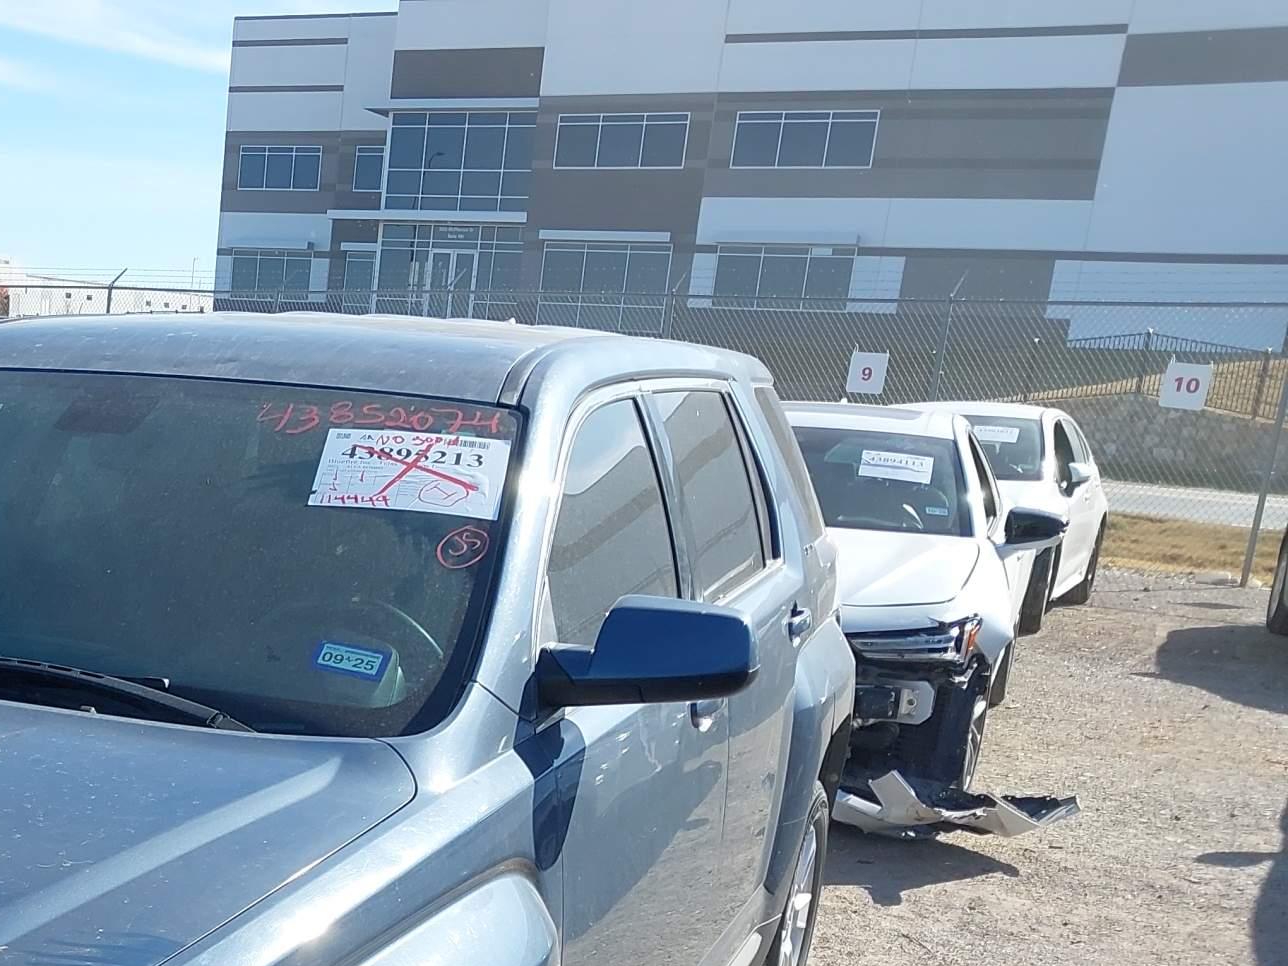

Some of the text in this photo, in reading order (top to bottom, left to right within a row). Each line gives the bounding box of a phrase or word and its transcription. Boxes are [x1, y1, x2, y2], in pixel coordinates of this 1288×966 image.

[861, 366, 873, 382] 9
[1174, 376, 1201, 394] 10
[257, 402, 501, 433] 43852074
[341, 445, 484, 468] 43895213
